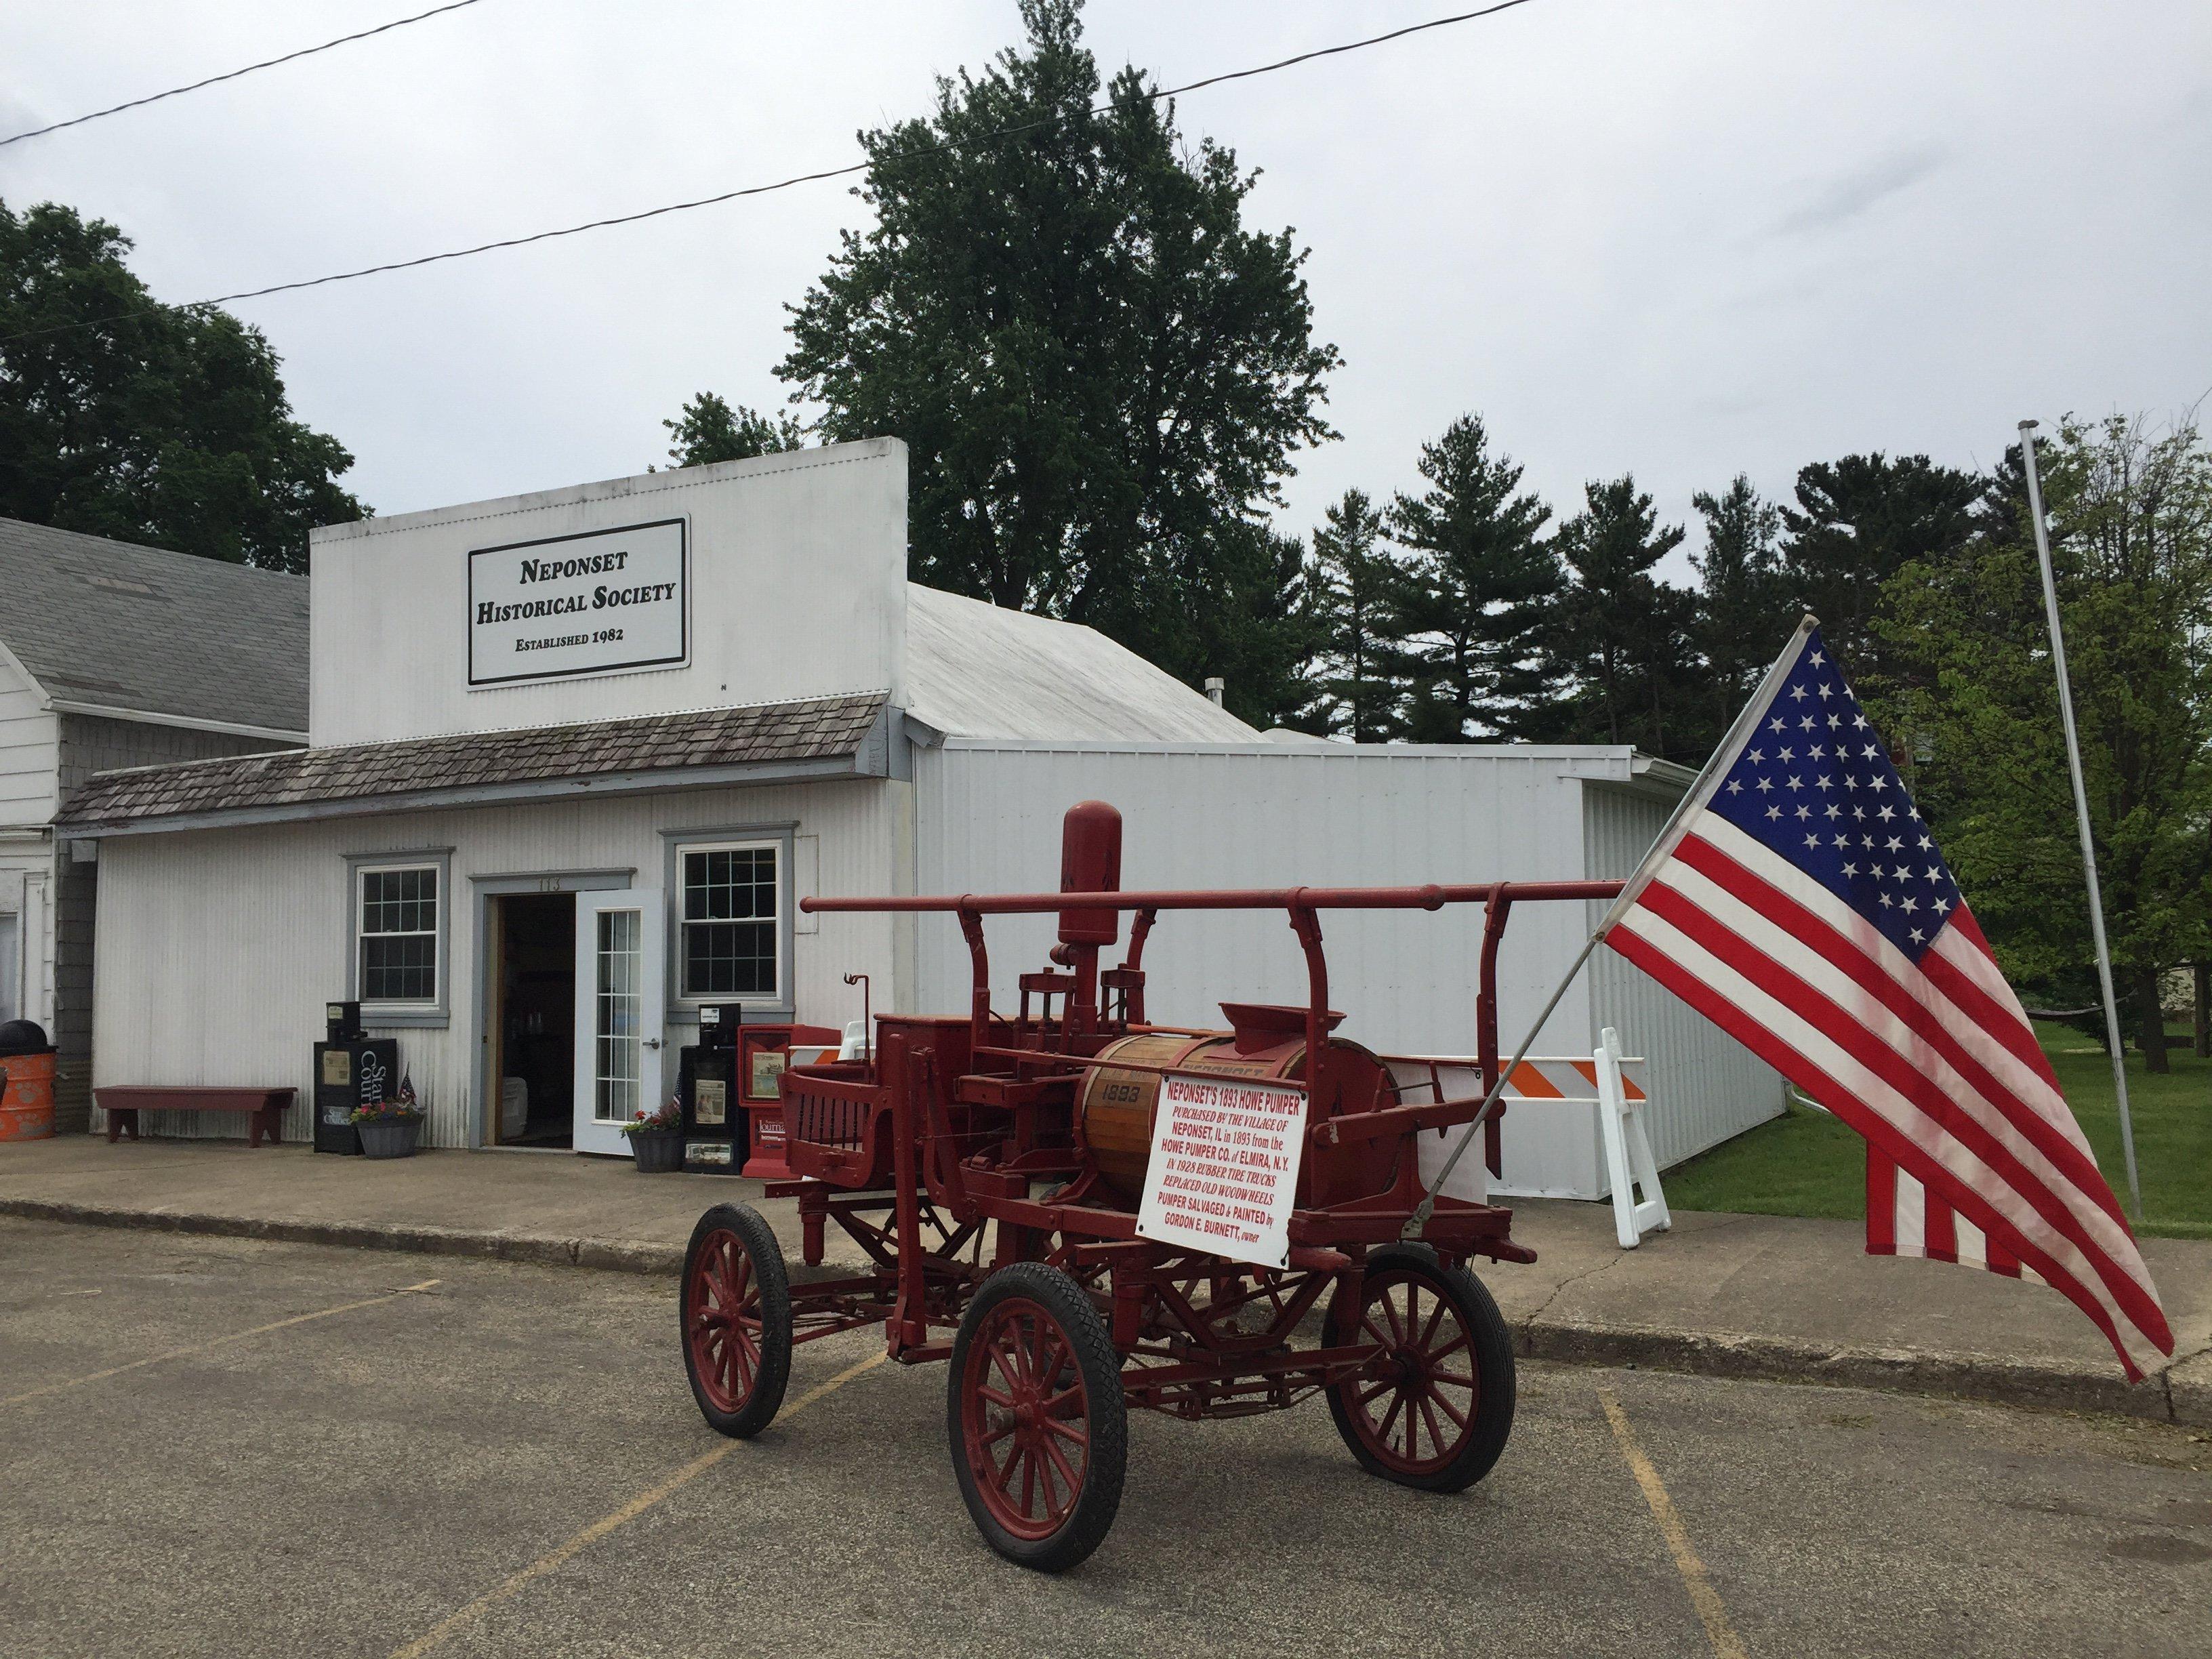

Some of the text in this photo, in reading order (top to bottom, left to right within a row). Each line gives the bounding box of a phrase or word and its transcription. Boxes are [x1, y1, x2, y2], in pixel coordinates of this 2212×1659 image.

[520, 552, 628, 584] NEPONSET
[476, 583, 676, 624] HISTORICAL SOCIETY
[515, 628, 623, 652] ESTABLISHED 1982
[539, 877, 560, 891] 113
[361, 1050, 376, 1106] Cour
[372, 1065, 386, 1102] Star
[1103, 1084, 1140, 1102] 1893
[1167, 1081, 1300, 1115] NEPONSET'S 1893 HOWE PUMPER
[759, 1120, 785, 1132] Journa
[1172, 1106, 1288, 1132] PURCHASED BY THE VILLAGE OF
[1172, 1122, 1284, 1151] NEPONSET, IL in 1893 from the
[1161, 1139, 1184, 1153] HOWE
[1185, 1142, 1216, 1160] PUMPER
[1218, 1147, 1229, 1162] CO.
[1231, 1151, 1239, 1162] of
[1240, 1150, 1271, 1171] ELMIRA,
[1166, 1158, 1277, 1187] IN 1928 RUBBER TIRE TRUCKS
[1163, 1174, 1274, 1206] REPLACED OLD WOODWHEELS
[1158, 1191, 1274, 1229] PUMPER SALVAGED & PAINTED by
[1165, 1212, 1259, 1243] GORDON E. BURNETT, owner
